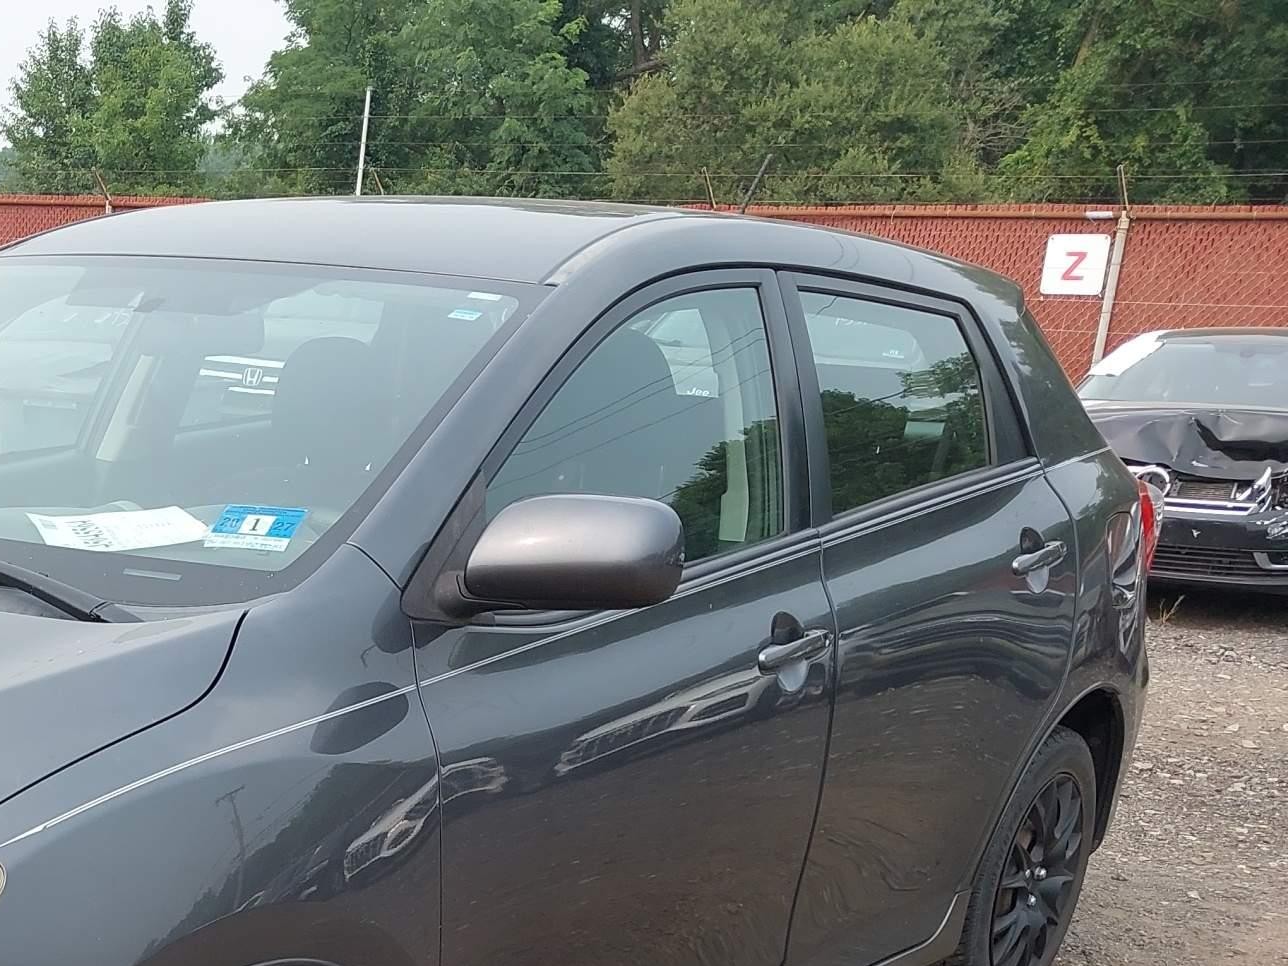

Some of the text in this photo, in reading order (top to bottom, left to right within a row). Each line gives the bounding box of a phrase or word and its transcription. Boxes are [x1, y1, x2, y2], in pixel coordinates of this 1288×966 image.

[1061, 252, 1088, 280] Z
[219, 517, 296, 532] 20 1 27
